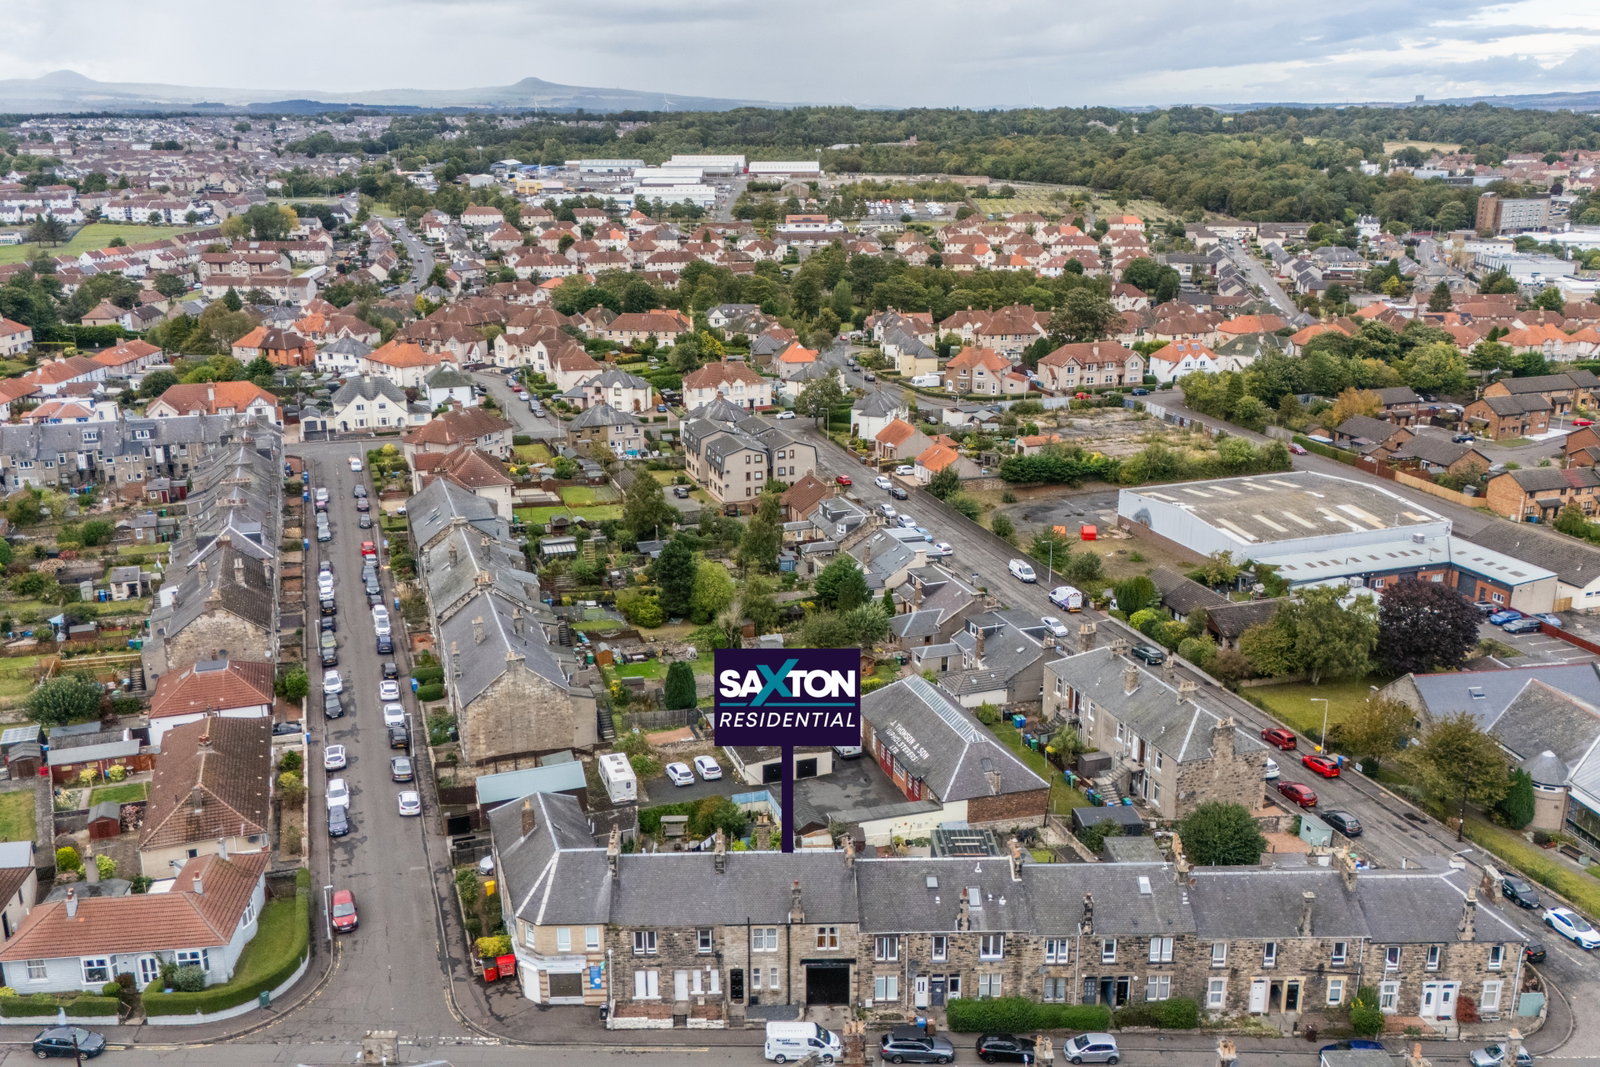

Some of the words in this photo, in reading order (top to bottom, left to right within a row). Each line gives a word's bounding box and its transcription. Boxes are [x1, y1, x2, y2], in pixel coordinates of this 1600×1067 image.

[894, 723, 916, 746] THOMSON
[912, 743, 920, 751] &
[916, 747, 930, 760] SON
